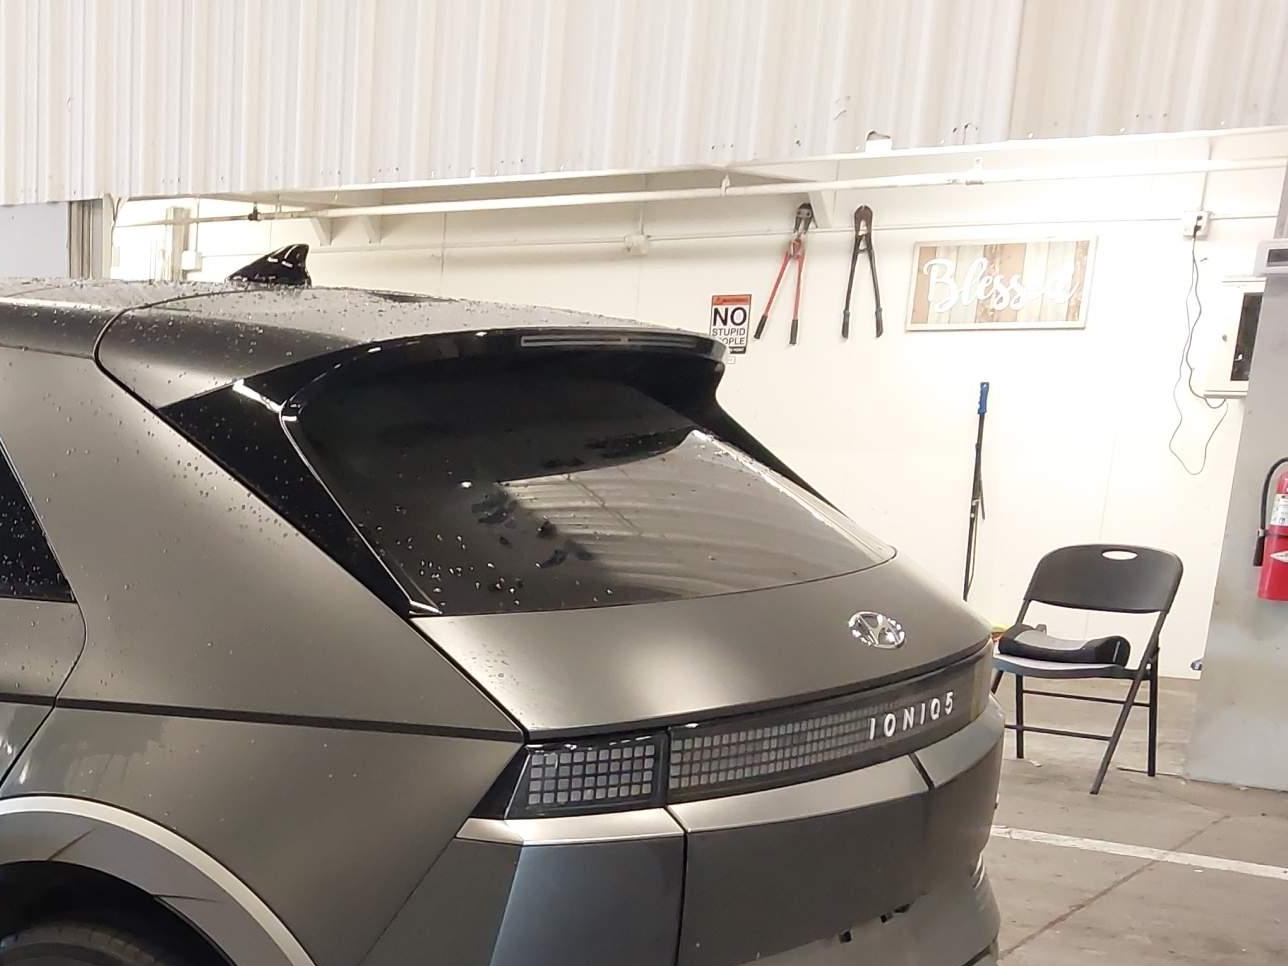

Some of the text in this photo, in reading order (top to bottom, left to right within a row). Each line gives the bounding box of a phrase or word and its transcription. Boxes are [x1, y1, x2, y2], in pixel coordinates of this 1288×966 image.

[713, 307, 747, 326] NO
[712, 327, 746, 337] STUPID
[720, 336, 746, 345] OPLE
